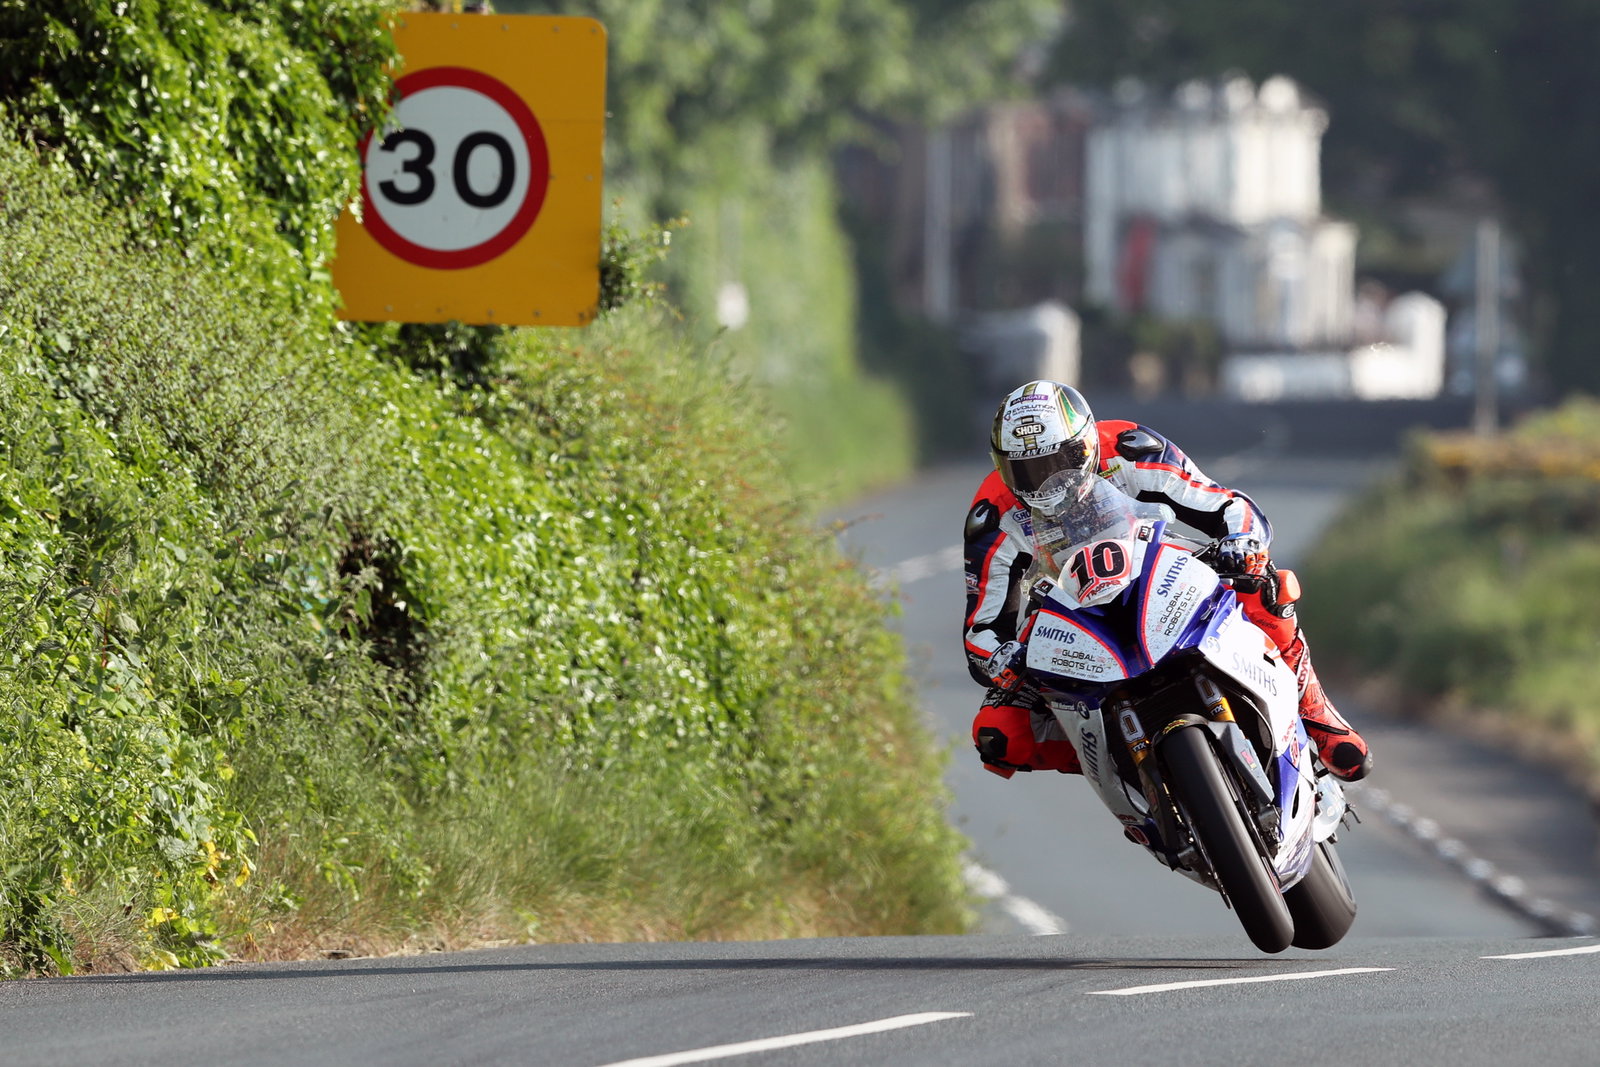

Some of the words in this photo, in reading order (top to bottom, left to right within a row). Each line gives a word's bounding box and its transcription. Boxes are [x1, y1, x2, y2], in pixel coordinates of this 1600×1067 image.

[378, 128, 516, 210] 30
[1013, 403, 1056, 413] EVOLUTION
[1015, 424, 1042, 437] SHOEI
[1008, 448, 1038, 459] NOLAN
[1040, 443, 1061, 454] OILS
[1070, 541, 1126, 600] 10
[1156, 556, 1189, 598] SMITHS
[1160, 591, 1184, 624] GLOBAL
[1164, 602, 1188, 637] ROBOTS
[1184, 585, 1197, 601] LTD
[1035, 625, 1076, 645] SMITHS
[1051, 657, 1086, 670] ROBOTS
[1086, 664, 1104, 674] LTD
[1062, 649, 1096, 662] GLOBAL
[1232, 652, 1277, 697] SMITHS
[1081, 727, 1101, 788] SMITHS
